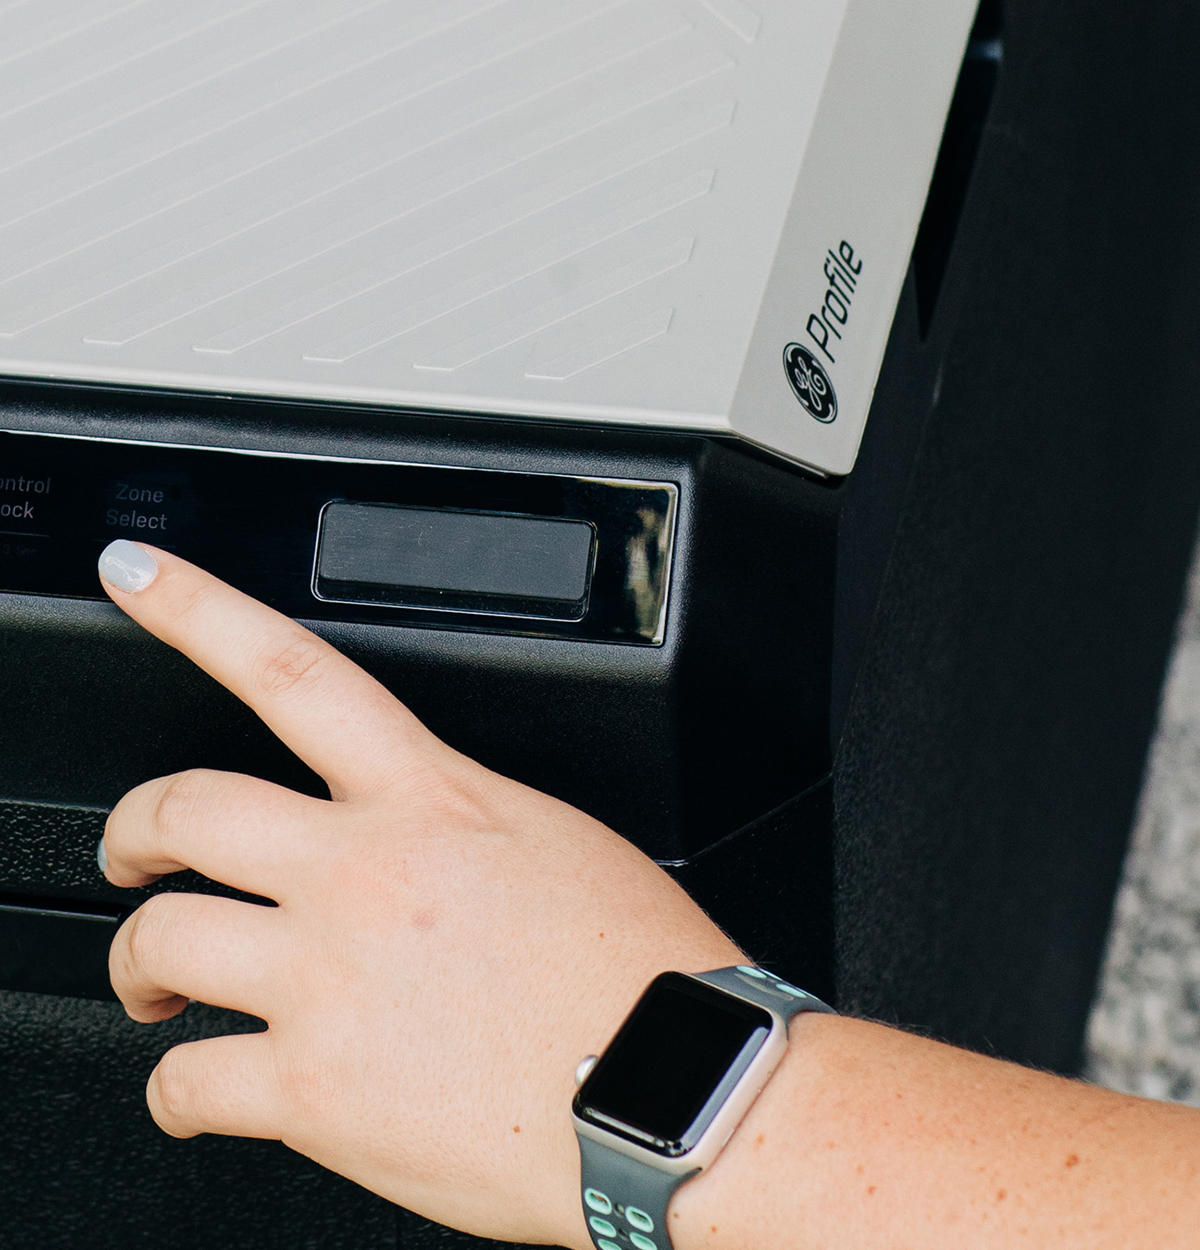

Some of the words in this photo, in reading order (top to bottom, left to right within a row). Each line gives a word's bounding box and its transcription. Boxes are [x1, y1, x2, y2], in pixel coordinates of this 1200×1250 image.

[806, 240, 862, 364] Profile
[115, 484, 164, 503] Zone
[105, 509, 168, 530] Select
